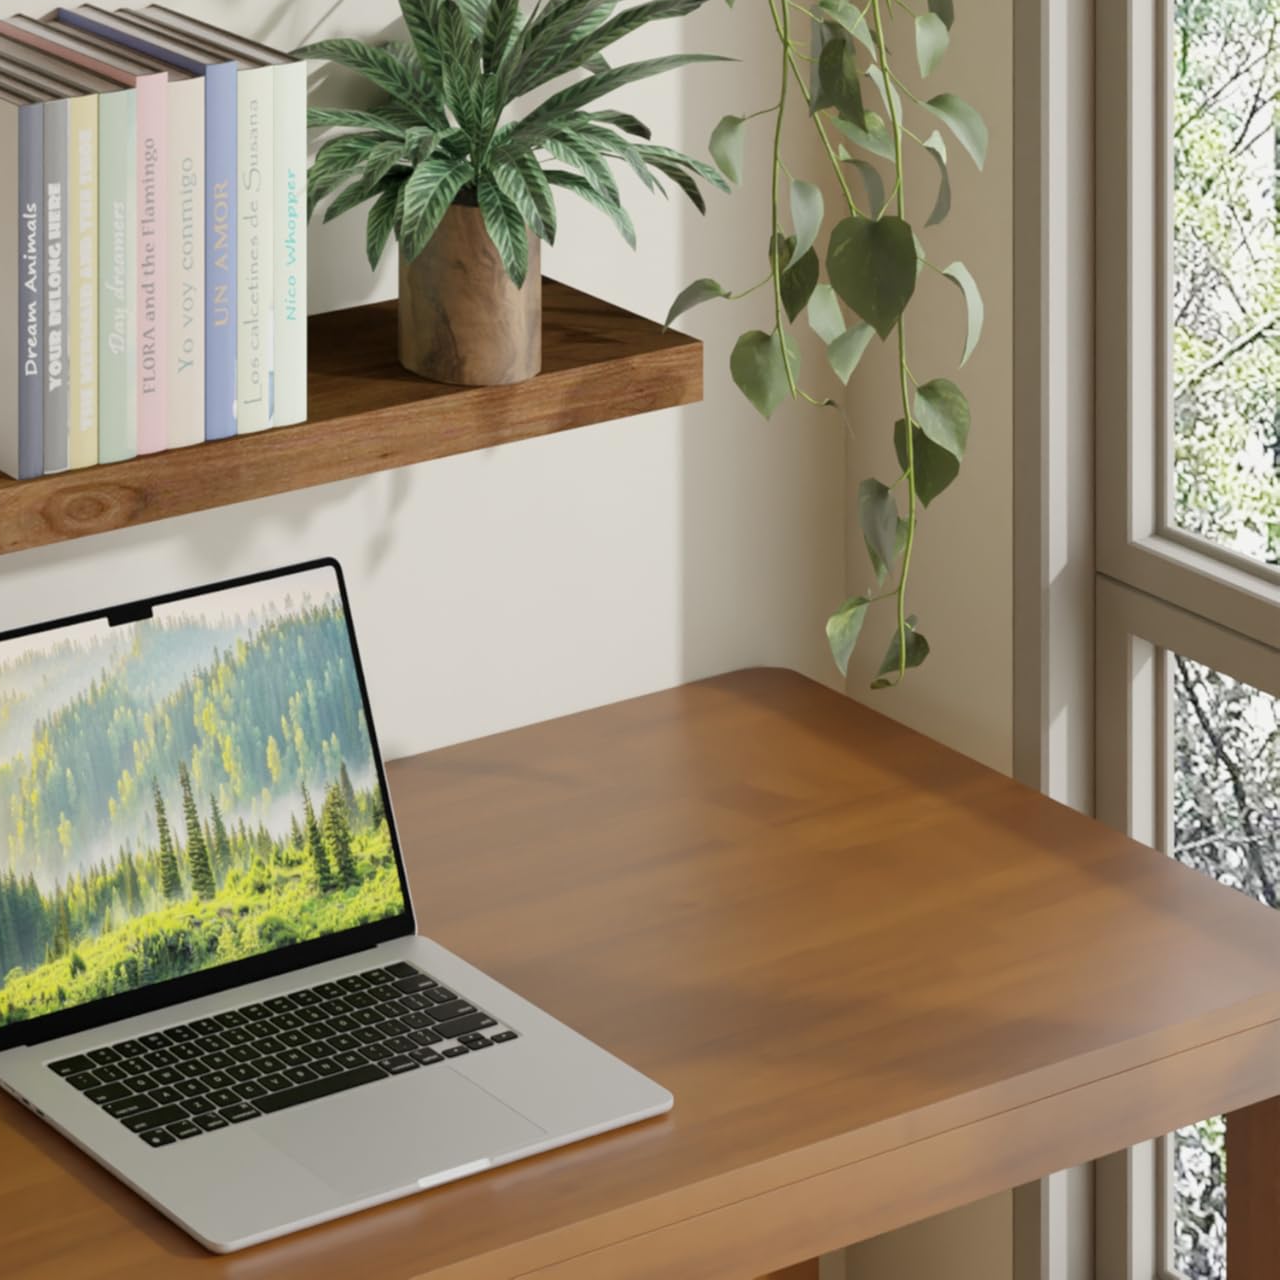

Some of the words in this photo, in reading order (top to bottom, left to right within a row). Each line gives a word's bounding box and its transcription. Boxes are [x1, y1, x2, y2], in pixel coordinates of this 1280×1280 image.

[243, 98, 262, 192] Susana
[48, 183, 62, 239] HERE
[142, 138, 157, 236] Flamingo
[178, 157, 197, 270] conmigo
[243, 200, 260, 228] de
[284, 169, 299, 266] Whopper
[23, 203, 38, 292] Animals
[106, 200, 125, 300] dreamers
[214, 180, 228, 270] AMOR
[48, 243, 62, 325] BELONG
[142, 243, 155, 276] the
[142, 283, 155, 321] and
[182, 283, 197, 327] voy
[214, 284, 228, 327] UN
[243, 235, 260, 350] calcetines
[284, 275, 297, 321] Nico
[23, 301, 38, 376] Dream
[48, 330, 62, 391] YOUR
[106, 308, 127, 354] Day
[142, 328, 156, 394] FLORA
[178, 338, 194, 373] Yo
[243, 358, 263, 404] Los
